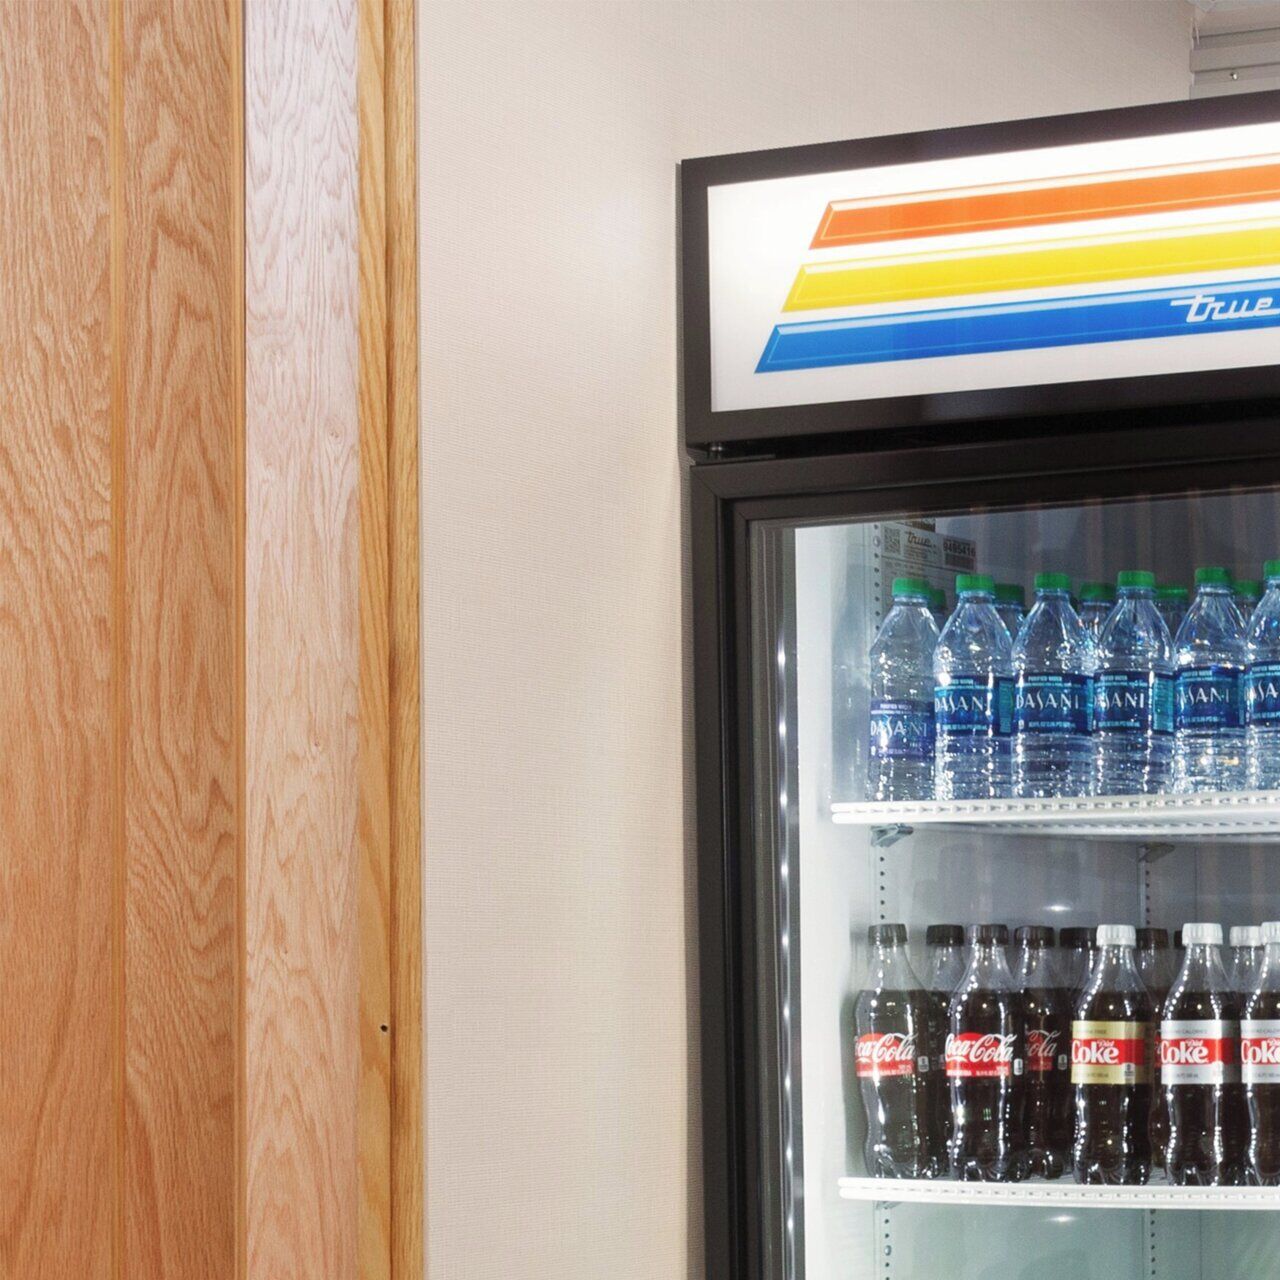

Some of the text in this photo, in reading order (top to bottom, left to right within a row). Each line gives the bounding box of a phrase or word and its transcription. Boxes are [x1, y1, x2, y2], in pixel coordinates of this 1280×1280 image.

[1016, 689, 1079, 711] DASANI
[1070, 1040, 1120, 1065] Coke
[1160, 1040, 1210, 1064] Coke
